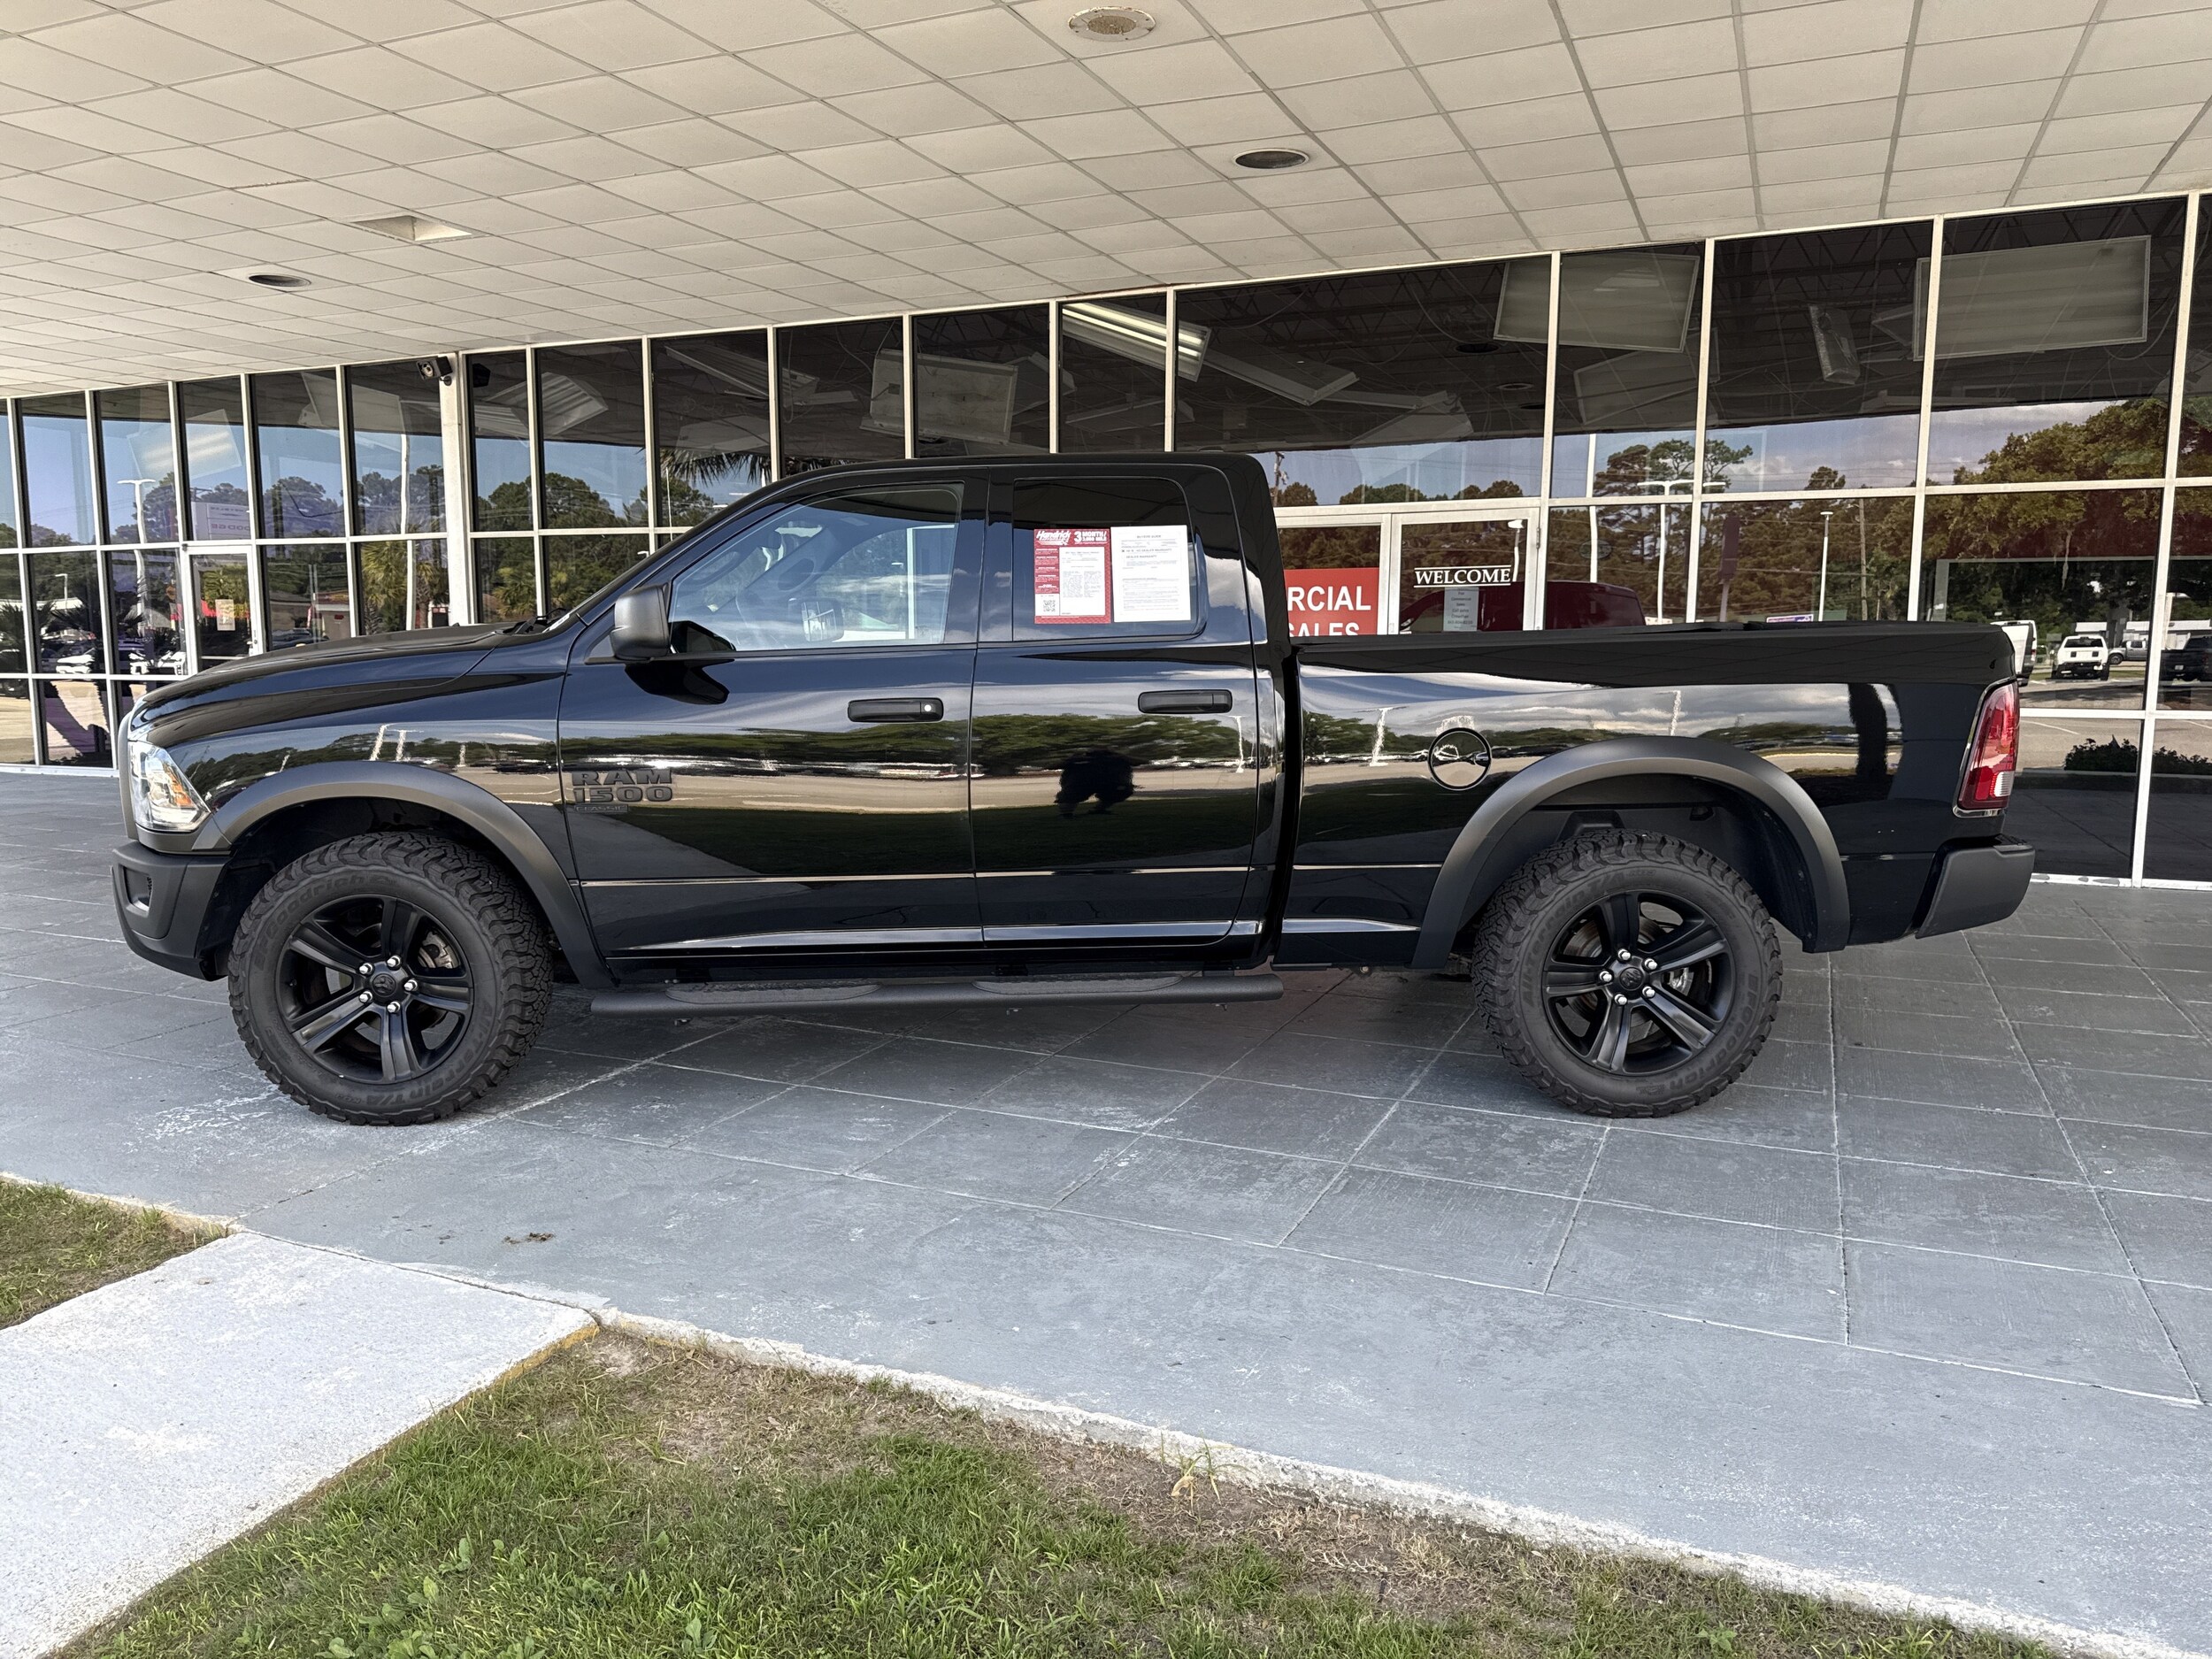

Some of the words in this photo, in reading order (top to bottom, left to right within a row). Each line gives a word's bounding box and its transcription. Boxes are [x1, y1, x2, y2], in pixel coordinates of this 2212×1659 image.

[1073, 531, 1082, 542] 3
[1414, 568, 1511, 585] WELCOME
[1287, 586, 1371, 611] RCIAL
[1288, 622, 1359, 637] ALES
[572, 768, 672, 786] RAM
[573, 787, 672, 803] 1500
